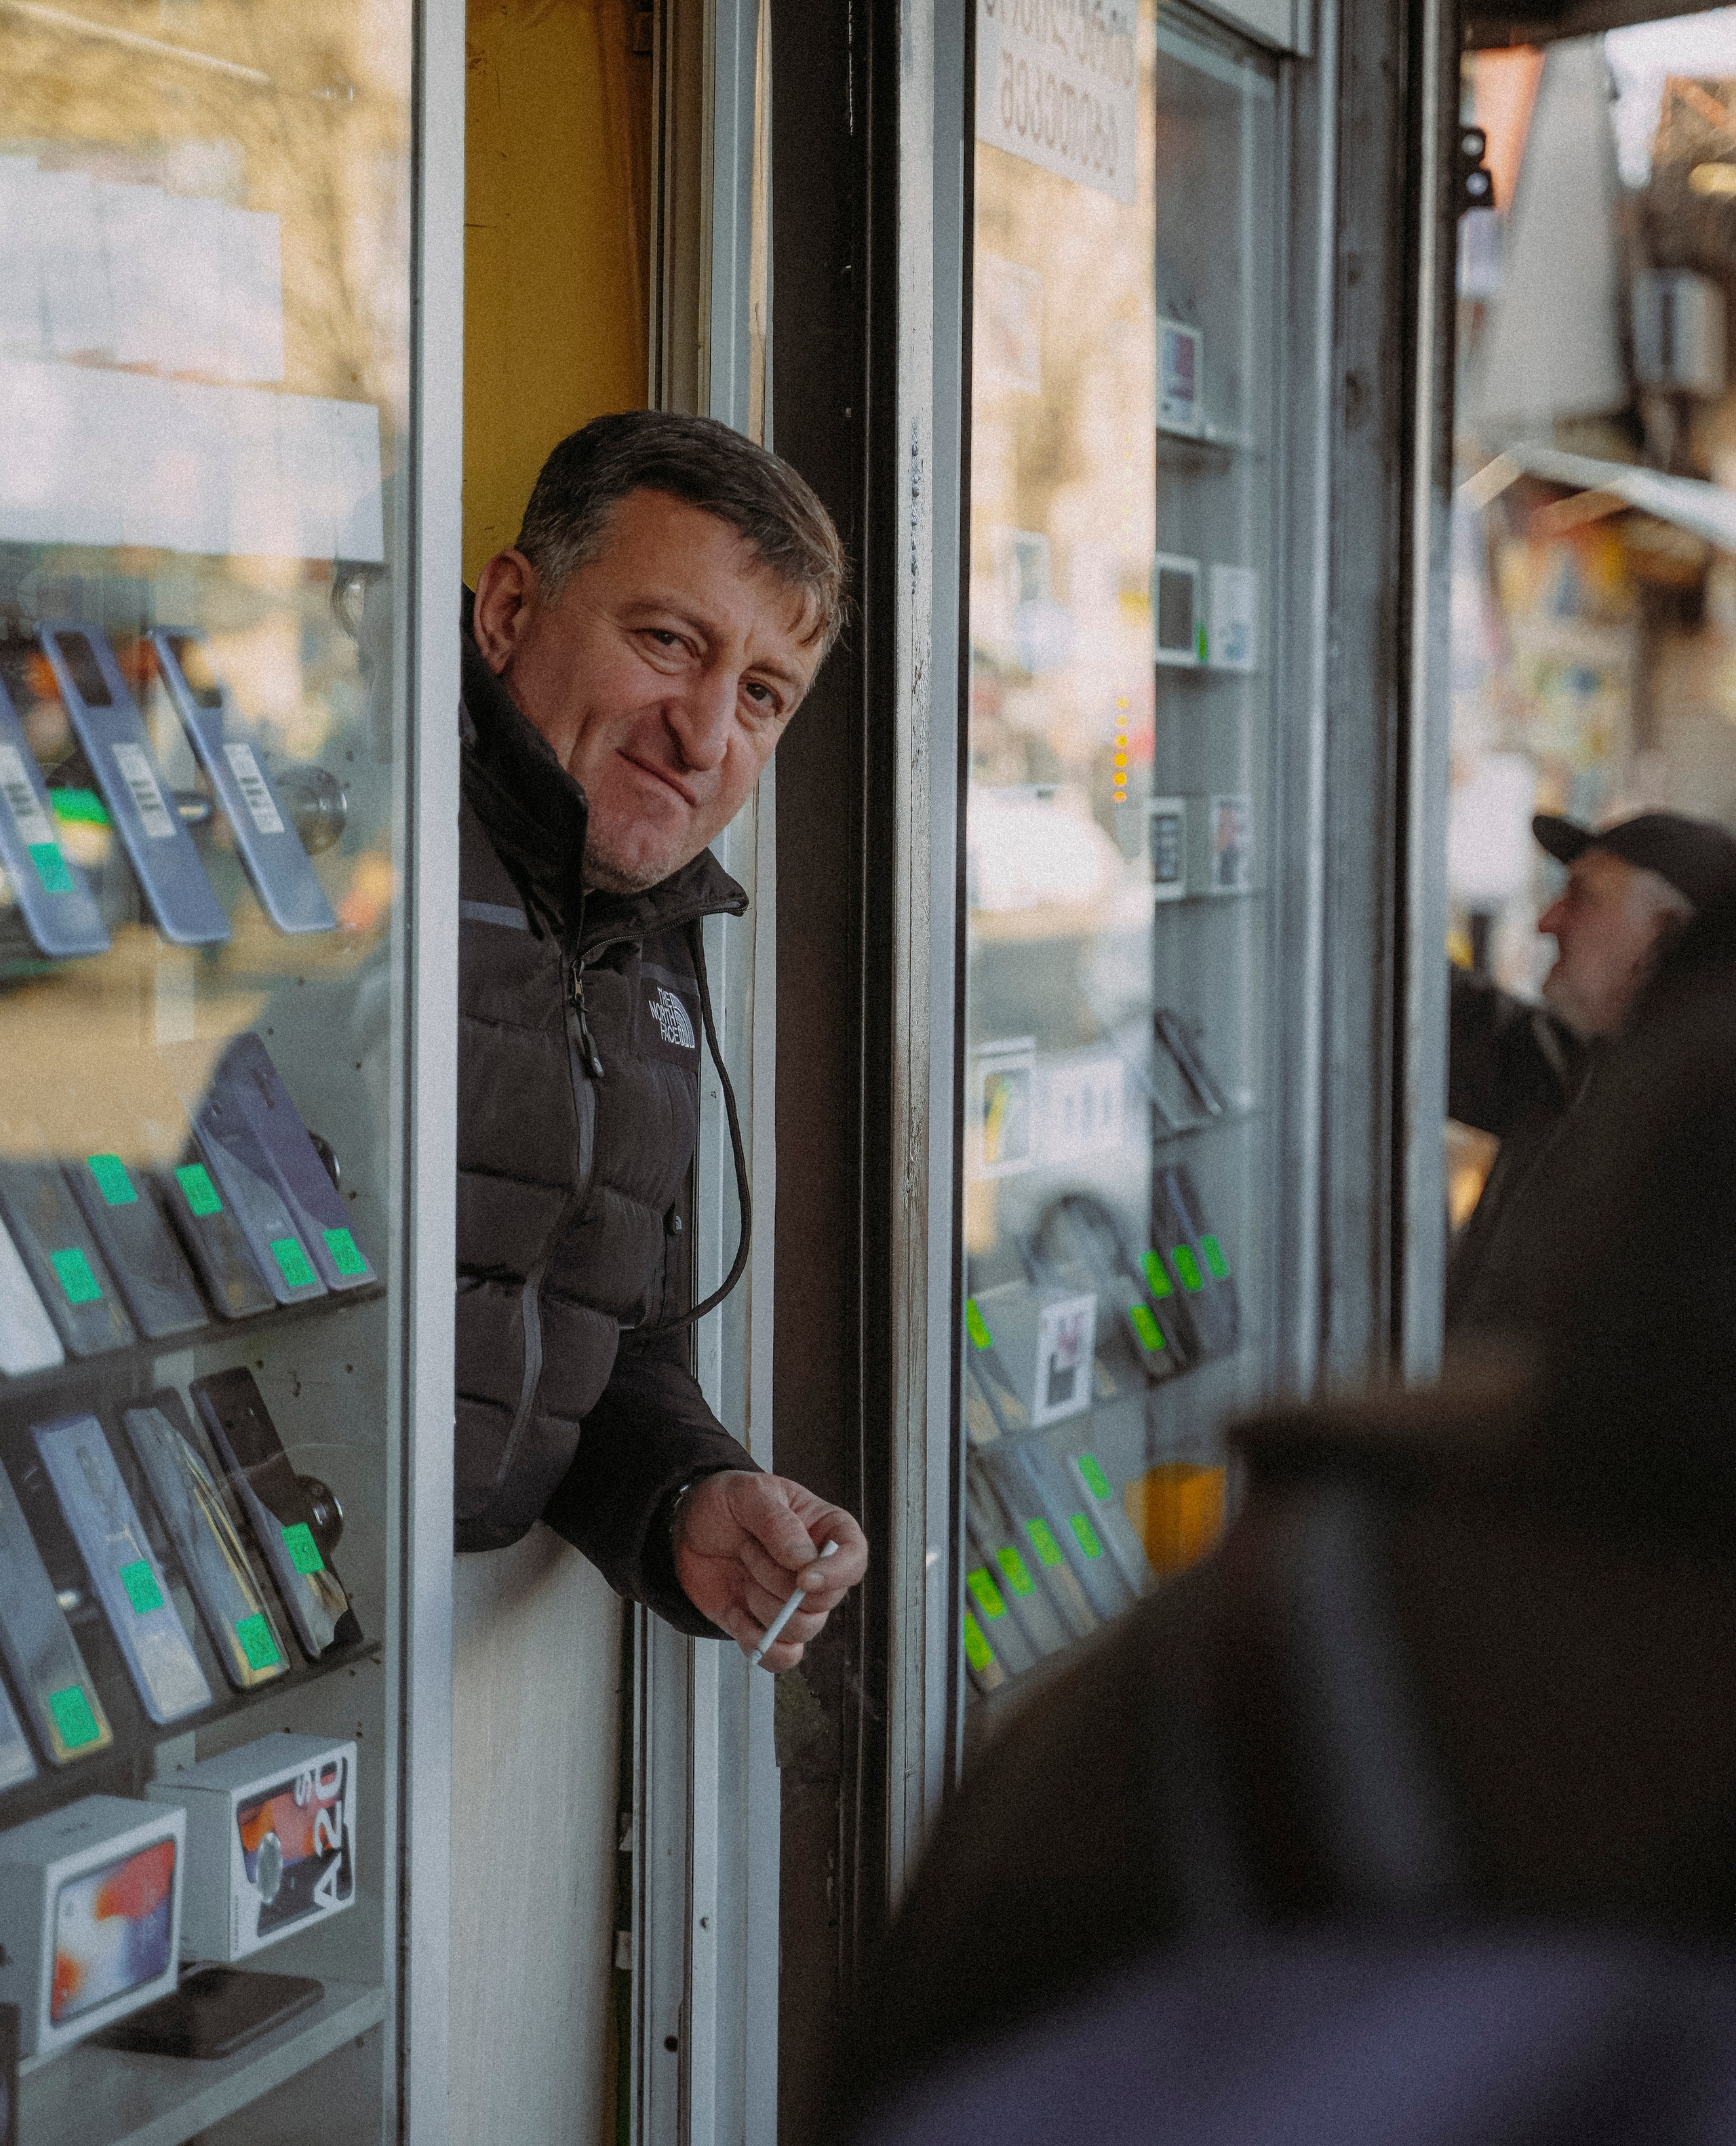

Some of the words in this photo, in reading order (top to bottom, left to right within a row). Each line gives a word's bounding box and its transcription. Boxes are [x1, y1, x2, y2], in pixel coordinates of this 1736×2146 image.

[656, 986, 673, 1009] THE
[648, 1000, 677, 1027] NORTH
[660, 1021, 680, 1045] FACE
